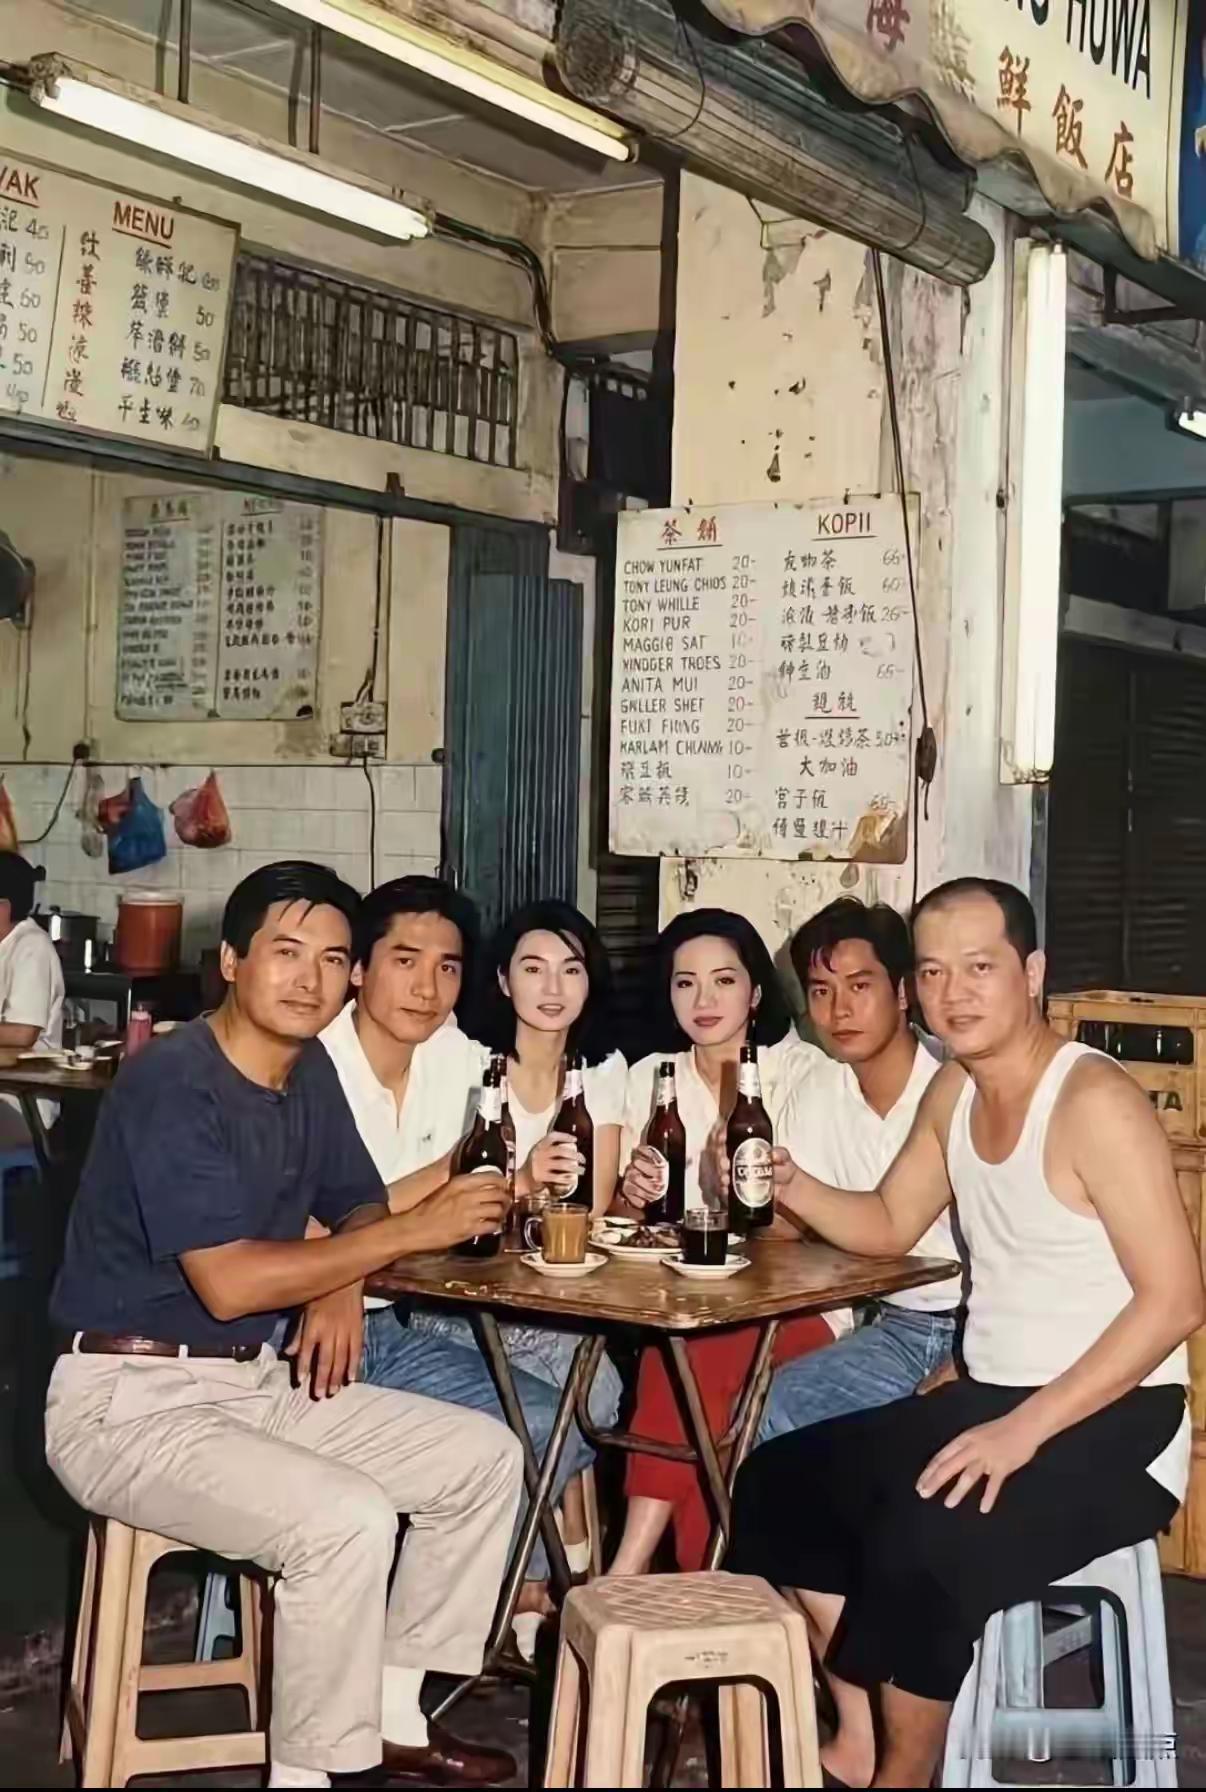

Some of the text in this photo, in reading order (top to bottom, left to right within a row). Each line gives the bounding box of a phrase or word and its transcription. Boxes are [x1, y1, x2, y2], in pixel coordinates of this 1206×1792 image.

[113, 201, 174, 240] MENU
[624, 560, 654, 574] CHOW
[660, 557, 703, 573] YUNFAT
[654, 577, 688, 593] LEUNG
[622, 600, 651, 613] TONY
[658, 596, 700, 612] WHILLE
[623, 618, 654, 632] KORI
[663, 616, 691, 631] PUR
[622, 677, 663, 693] ANITA
[673, 676, 698, 692] MUI
[800, 755, 858, 777] 大加油
